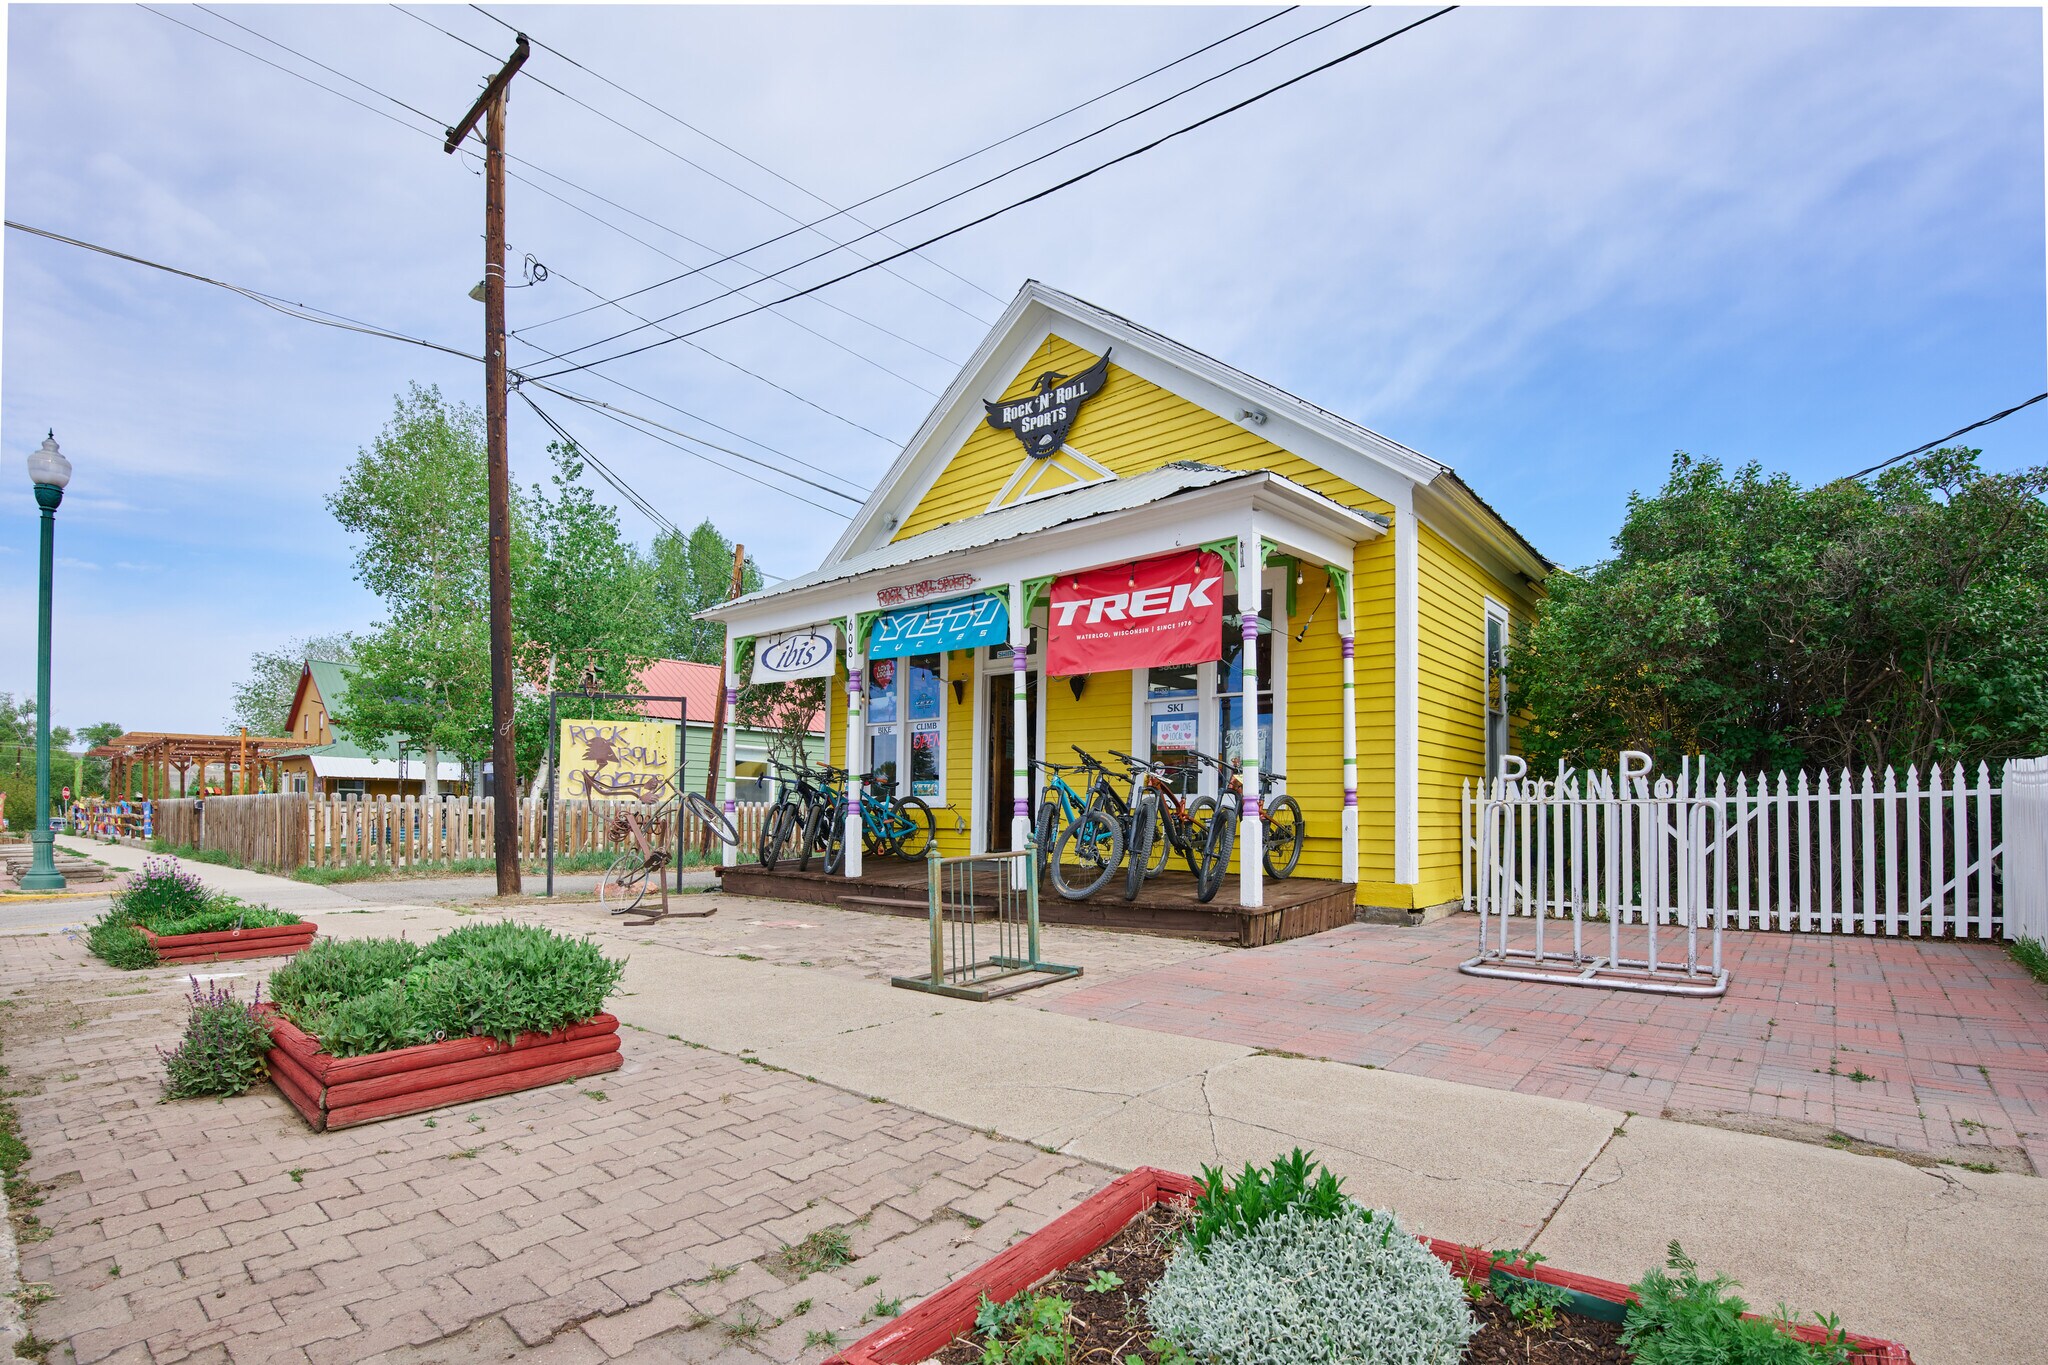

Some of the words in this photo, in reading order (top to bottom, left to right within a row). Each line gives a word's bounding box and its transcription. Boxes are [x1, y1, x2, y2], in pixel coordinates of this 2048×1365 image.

[1051, 576, 1221, 627] TREK
[878, 597, 1001, 641] YETI
[1076, 632, 1111, 641] WATERLOO,
[1113, 627, 1149, 637] WISCONSIN
[1157, 623, 1175, 632] SINCE
[1178, 620, 1192, 628] 1976
[776, 636, 815, 669] ibis
[1167, 703, 1184, 713] SKI
[569, 725, 631, 745] ROCK
[878, 726, 892, 734] BIKE
[916, 722, 937, 731] CLIMB
[1161, 723, 1171, 732] LIVE
[1181, 721, 1192, 731] LOVE
[913, 732, 940, 750] OPEN
[1170, 731, 1184, 741] LOCAL
